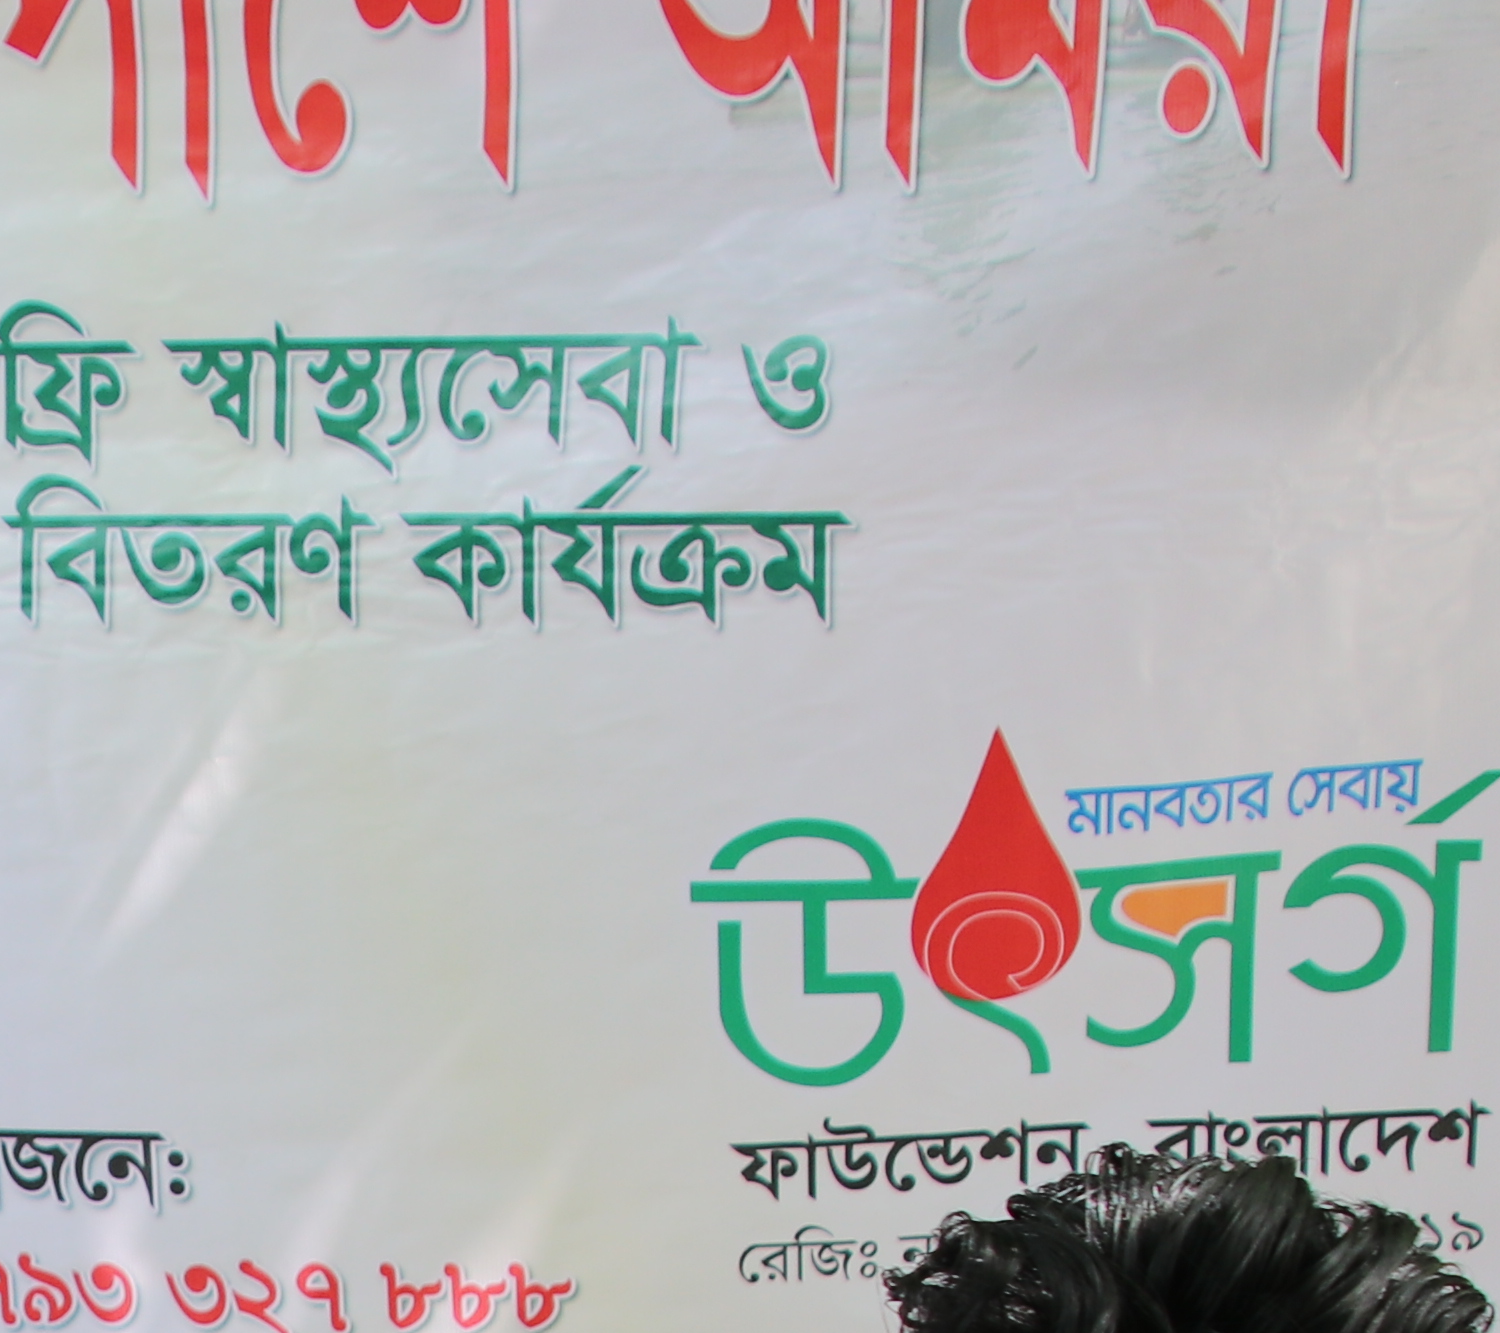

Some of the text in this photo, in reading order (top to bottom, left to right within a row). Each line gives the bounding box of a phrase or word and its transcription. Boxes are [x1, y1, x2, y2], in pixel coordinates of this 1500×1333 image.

[162, 315, 703, 474] স্বাস্থ্যসেবা
[741, 335, 829, 432] ও
[2, 473, 380, 626] বিতরণ
[400, 465, 854, 627] কার্যক্রম
[1063, 758, 1424, 837] মানবতার সেবায়
[729, 1117, 1092, 1200] ফাউন্ডেশন
[380, 1262, 576, 1331] ৮৮৮
